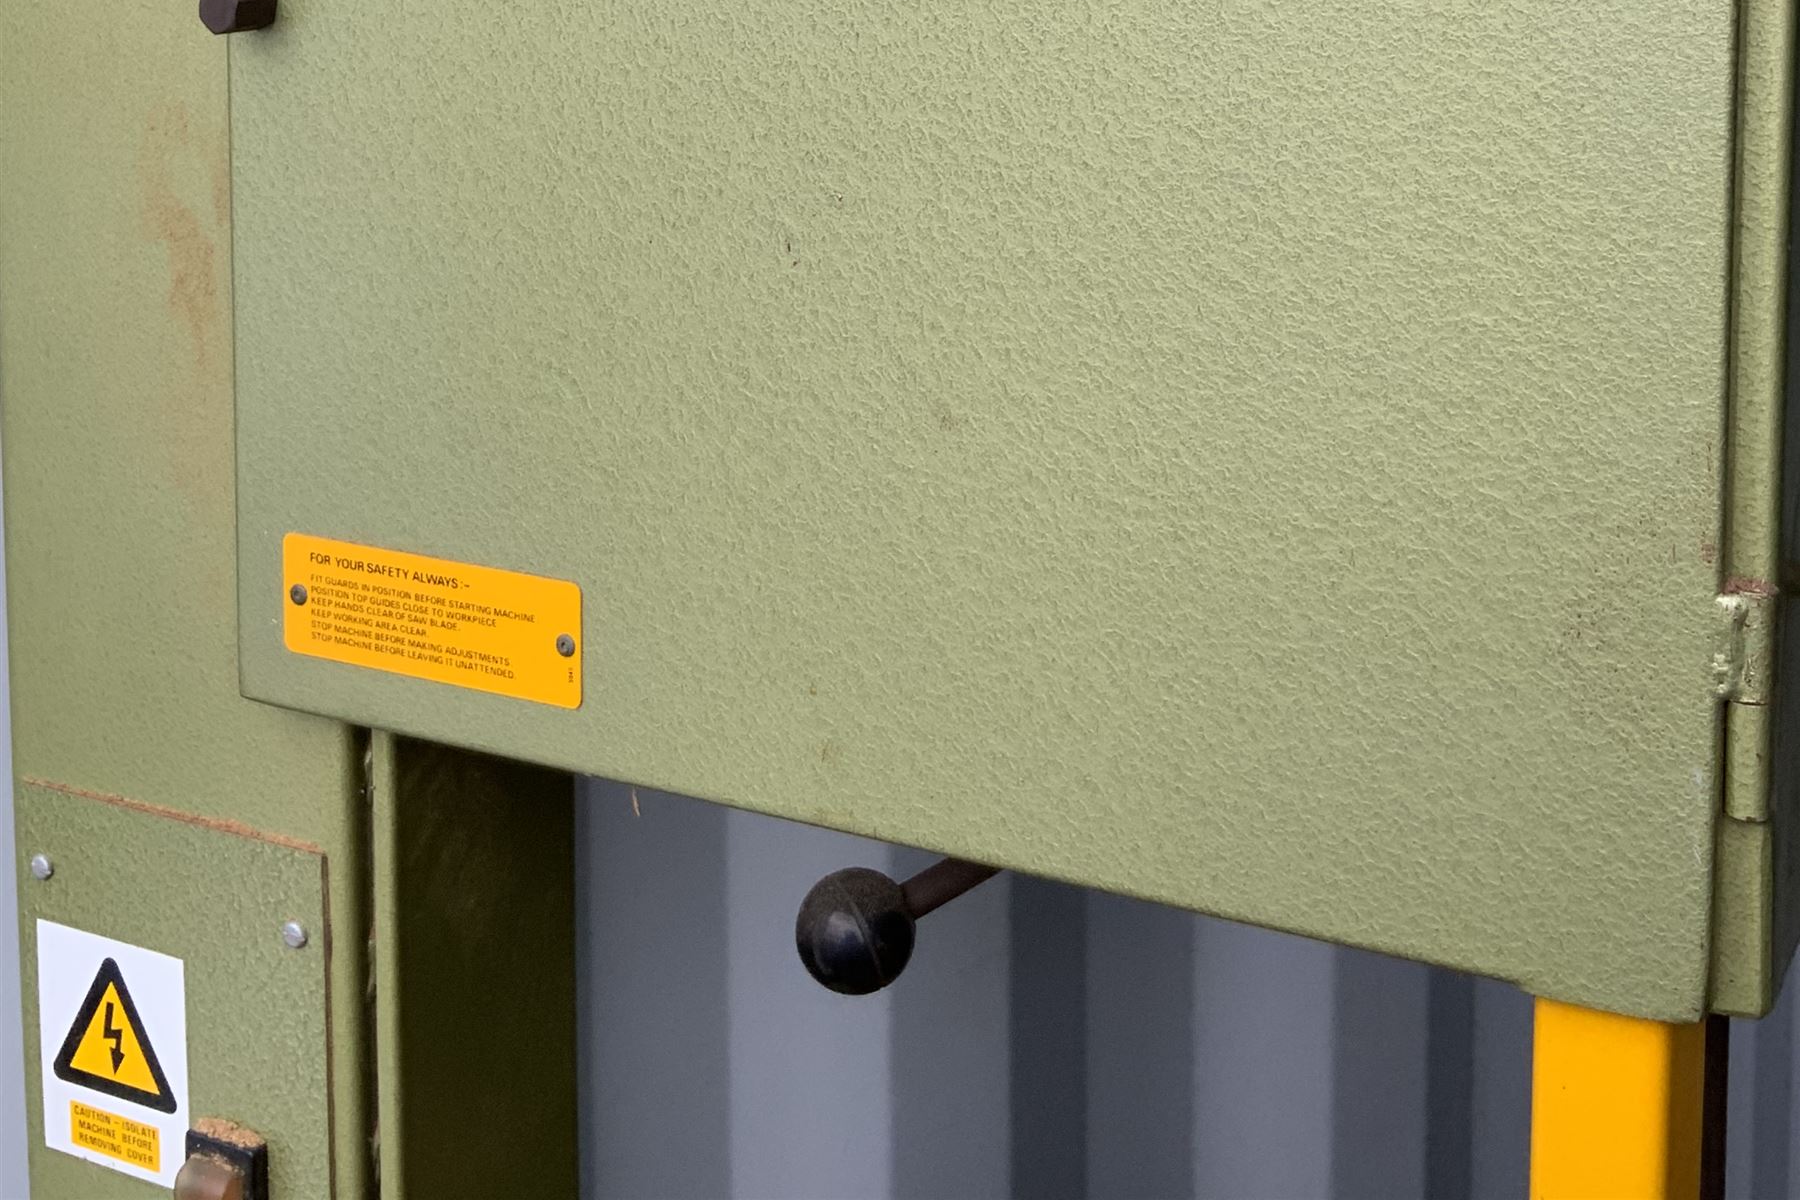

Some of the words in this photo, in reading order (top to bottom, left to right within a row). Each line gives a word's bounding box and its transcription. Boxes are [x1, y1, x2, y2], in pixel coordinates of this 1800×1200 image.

[310, 552, 331, 566] FOR
[335, 557, 365, 572] YOUR
[366, 563, 410, 580] SAFETY
[310, 574, 323, 583] FIT
[324, 575, 359, 590] GUARDS
[361, 583, 371, 592] IN
[372, 584, 412, 600] POSITION
[414, 592, 447, 607] BEFORE
[448, 600, 492, 616] STARTING
[493, 608, 536, 623] MACHINE
[311, 585, 349, 600] POSITION
[351, 592, 369, 603] TOP
[369, 595, 401, 610] GUIDES
[402, 602, 429, 616] CLOSE
[432, 607, 444, 618] TO
[446, 610, 497, 628] WORKPIECE
[311, 597, 334, 607] KEEP
[334, 599, 365, 613] HANDS
[366, 606, 394, 619] CLEAR
[394, 611, 406, 621] OF
[407, 614, 428, 626] SAW
[311, 608, 332, 618] KEEP
[333, 612, 374, 629] WORKING
[375, 618, 398, 632] AREA
[311, 620, 333, 631] STOP
[334, 624, 373, 640] MACHINE
[374, 632, 406, 647] BEFORE
[407, 639, 443, 654] MAKING
[311, 631, 333, 642] STOP
[334, 636, 373, 651] MACHINE
[374, 643, 406, 658] BEFORE
[407, 650, 444, 666] LEAVING
[445, 657, 453, 667] IT
[74, 1104, 111, 1125] CAUTION
[121, 1121, 156, 1141] ISOLATE
[78, 1119, 116, 1140] MACHINE
[121, 1132, 153, 1152] BEFORE
[78, 1132, 122, 1155] REMOVING
[126, 1147, 154, 1165] COVER
